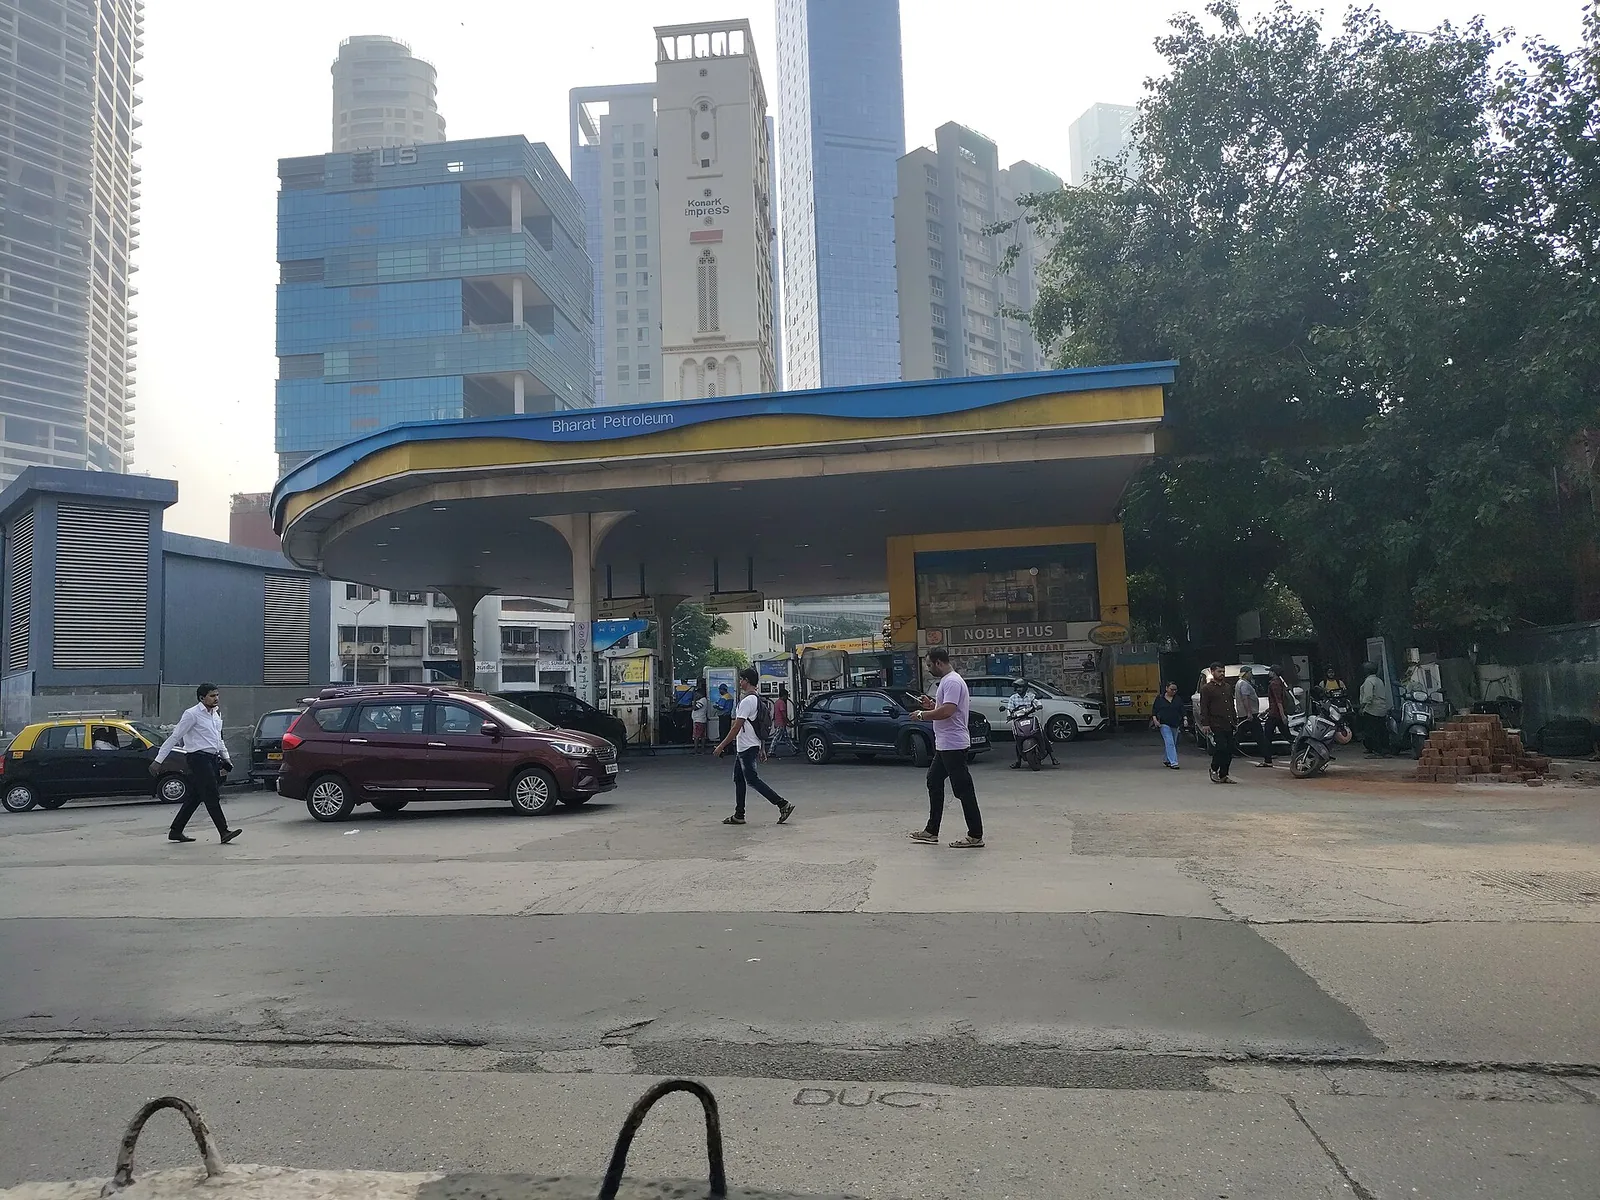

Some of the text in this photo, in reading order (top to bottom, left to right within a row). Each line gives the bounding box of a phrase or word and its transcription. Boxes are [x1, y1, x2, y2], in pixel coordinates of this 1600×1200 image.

[552, 413, 674, 433] Bharat Petroleum
[964, 625, 1054, 640] NOBLE PLUS
